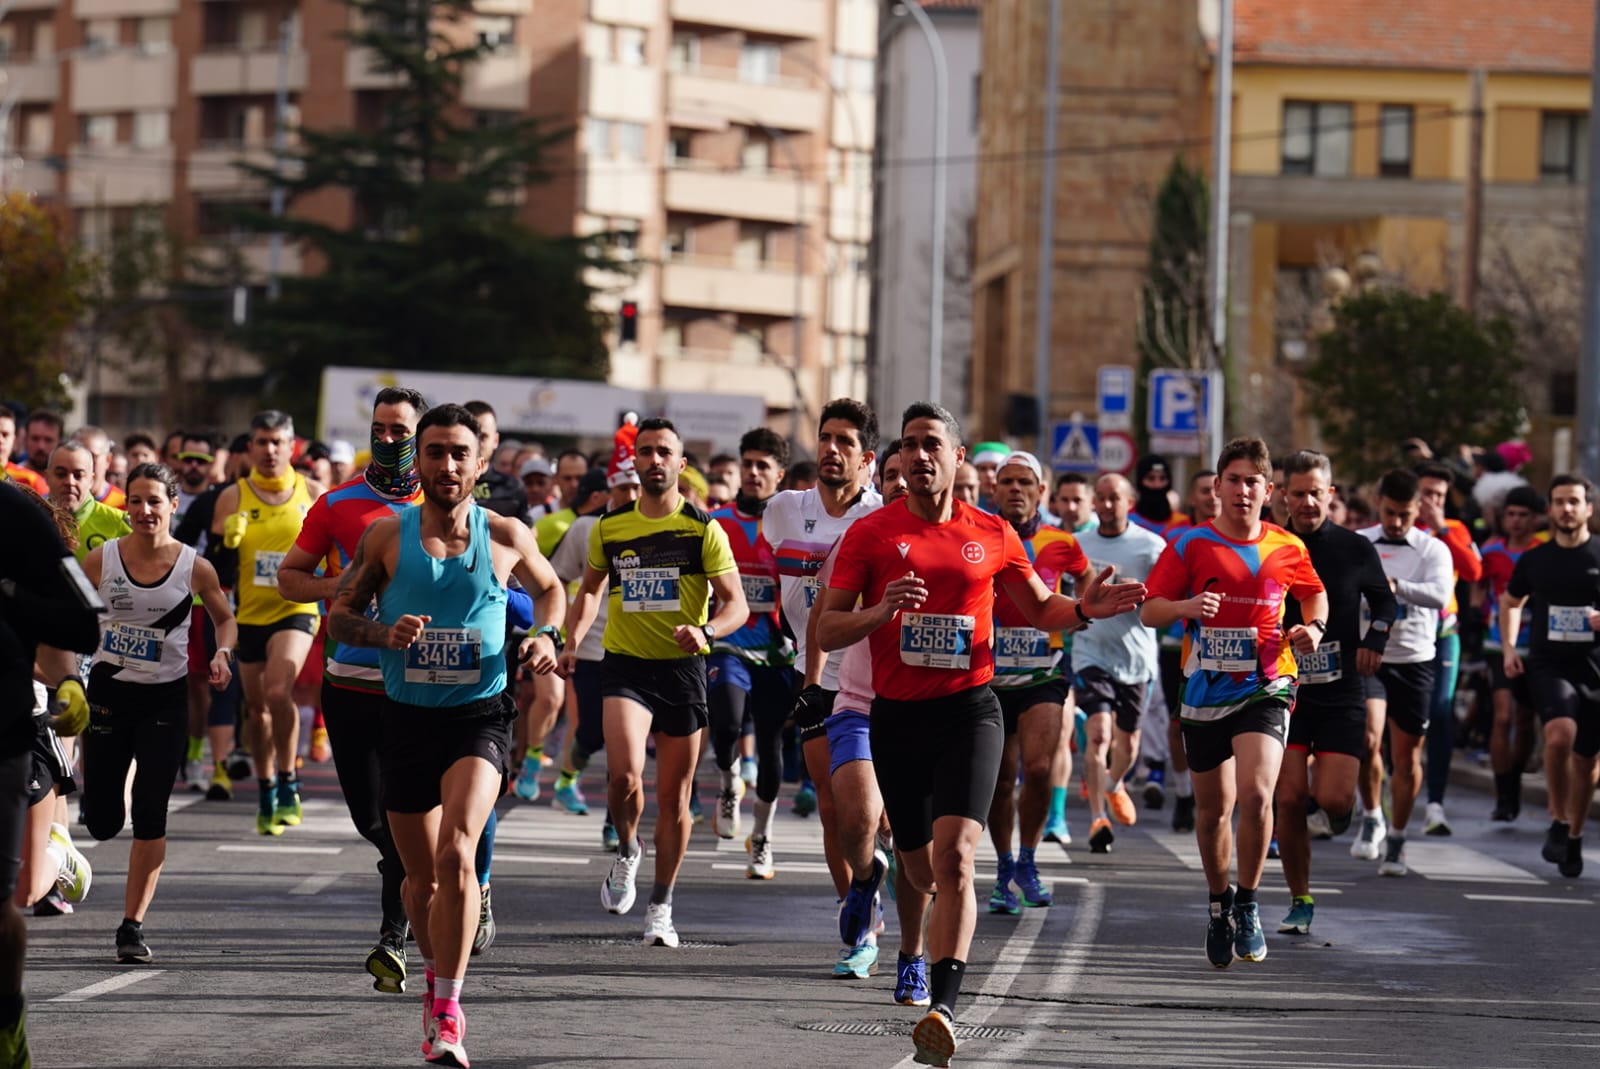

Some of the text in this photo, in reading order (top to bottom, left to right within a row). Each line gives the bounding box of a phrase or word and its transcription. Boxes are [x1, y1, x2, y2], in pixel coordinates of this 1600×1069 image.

[635, 570, 674, 578] SETEL
[628, 580, 665, 599] 3474
[922, 615, 970, 628] SETEL
[120, 625, 160, 640] SETEL
[425, 631, 475, 642] SETEL
[910, 626, 958, 651] 3585
[1213, 629, 1252, 638] SETEL
[110, 632, 149, 658] 3523
[1003, 637, 1038, 655] 3437
[1207, 639, 1244, 657] 3644
[418, 643, 461, 667] 3413
